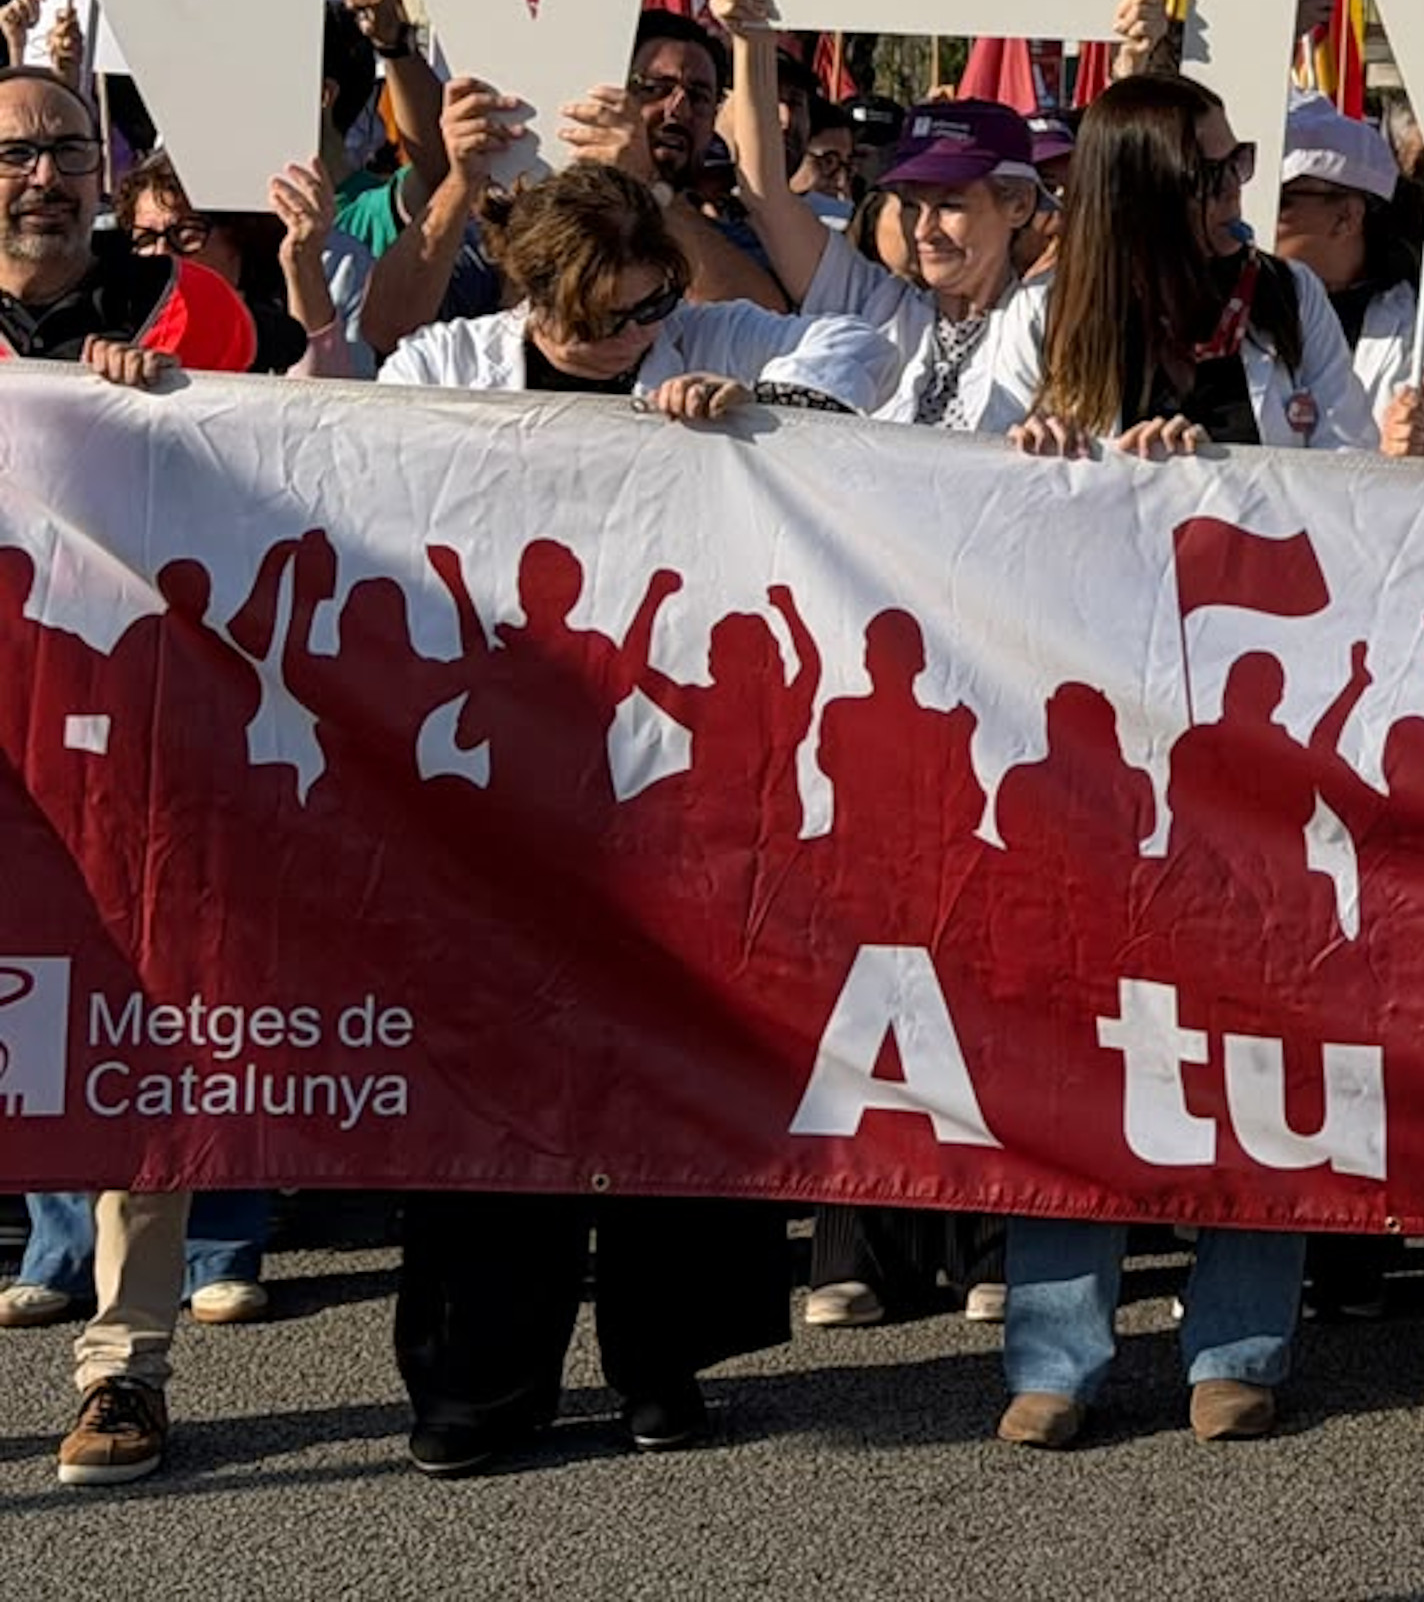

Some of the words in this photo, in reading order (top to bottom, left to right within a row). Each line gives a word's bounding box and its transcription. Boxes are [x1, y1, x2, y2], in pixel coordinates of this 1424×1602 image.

[88, 992, 322, 1059] Metges
[336, 994, 414, 1048] de
[86, 1060, 409, 1130] Catalunya
[788, 944, 1003, 1148] A
[1096, 977, 1388, 1181] tu
